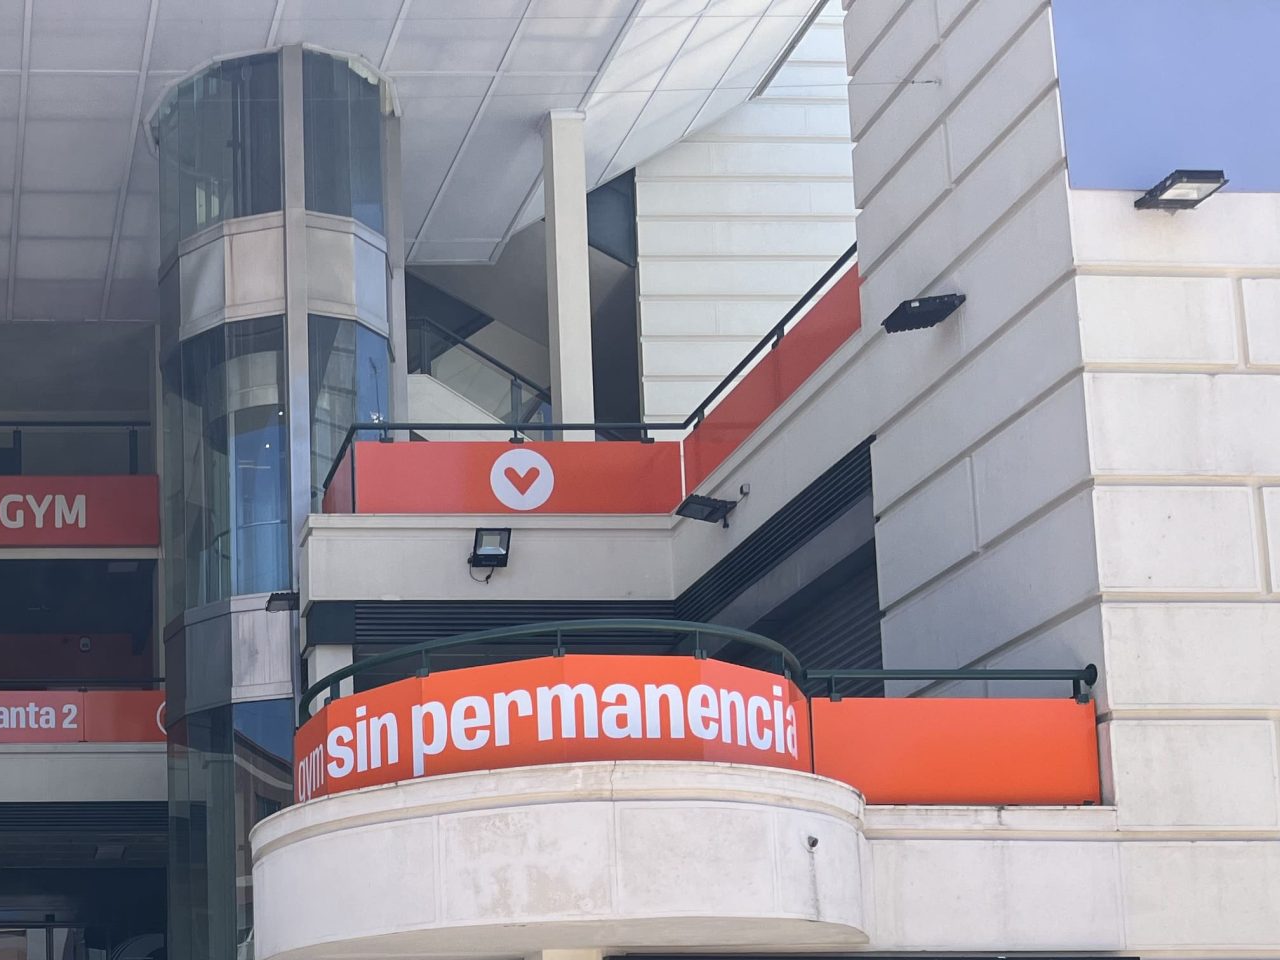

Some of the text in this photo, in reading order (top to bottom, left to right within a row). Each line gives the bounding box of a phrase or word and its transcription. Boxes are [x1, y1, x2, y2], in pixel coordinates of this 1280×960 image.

[62, 704, 78, 729] 2
[326, 704, 399, 778] sin
[411, 683, 799, 777] permanencia
